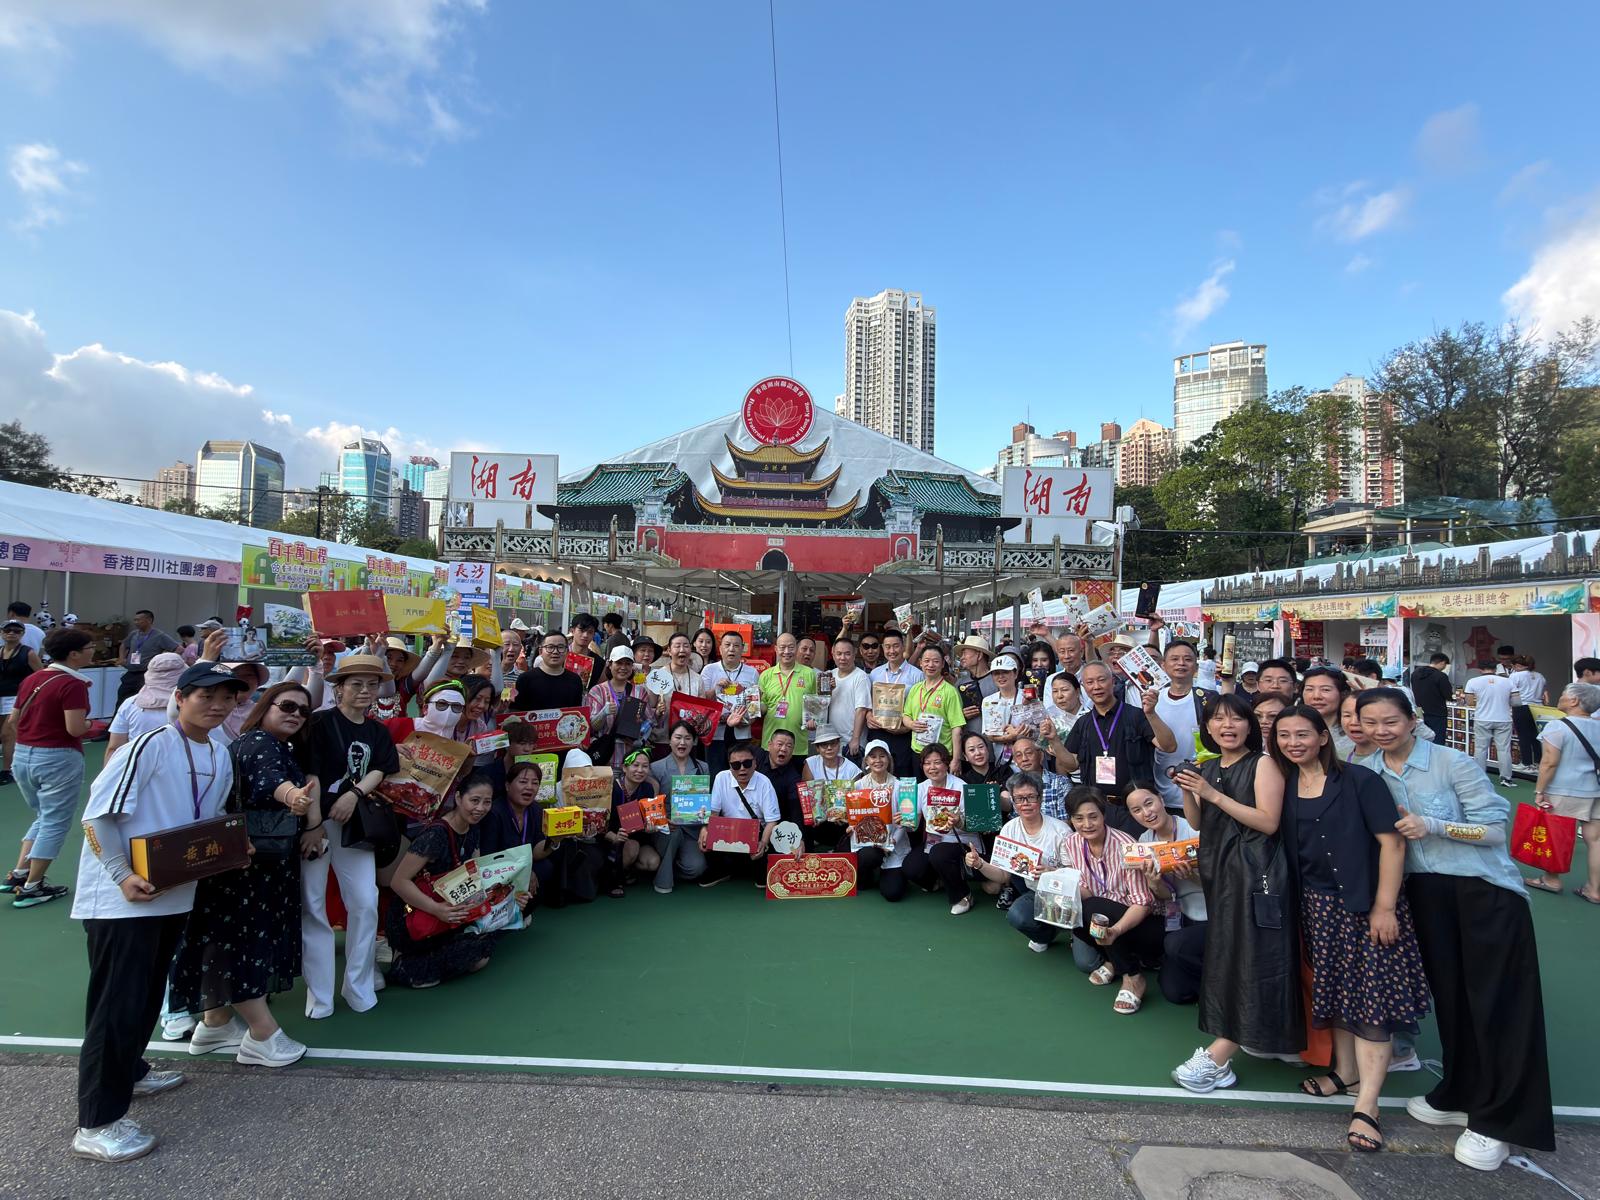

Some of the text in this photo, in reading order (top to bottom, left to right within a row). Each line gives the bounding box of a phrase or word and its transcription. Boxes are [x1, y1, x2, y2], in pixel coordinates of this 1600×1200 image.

[748, 417, 765, 440] Fraternal
[471, 456, 537, 500] 湖南
[1024, 470, 1092, 516] 湖南
[268, 537, 328, 564] 百千萬工程
[103, 553, 218, 578] 香港四川社團總會
